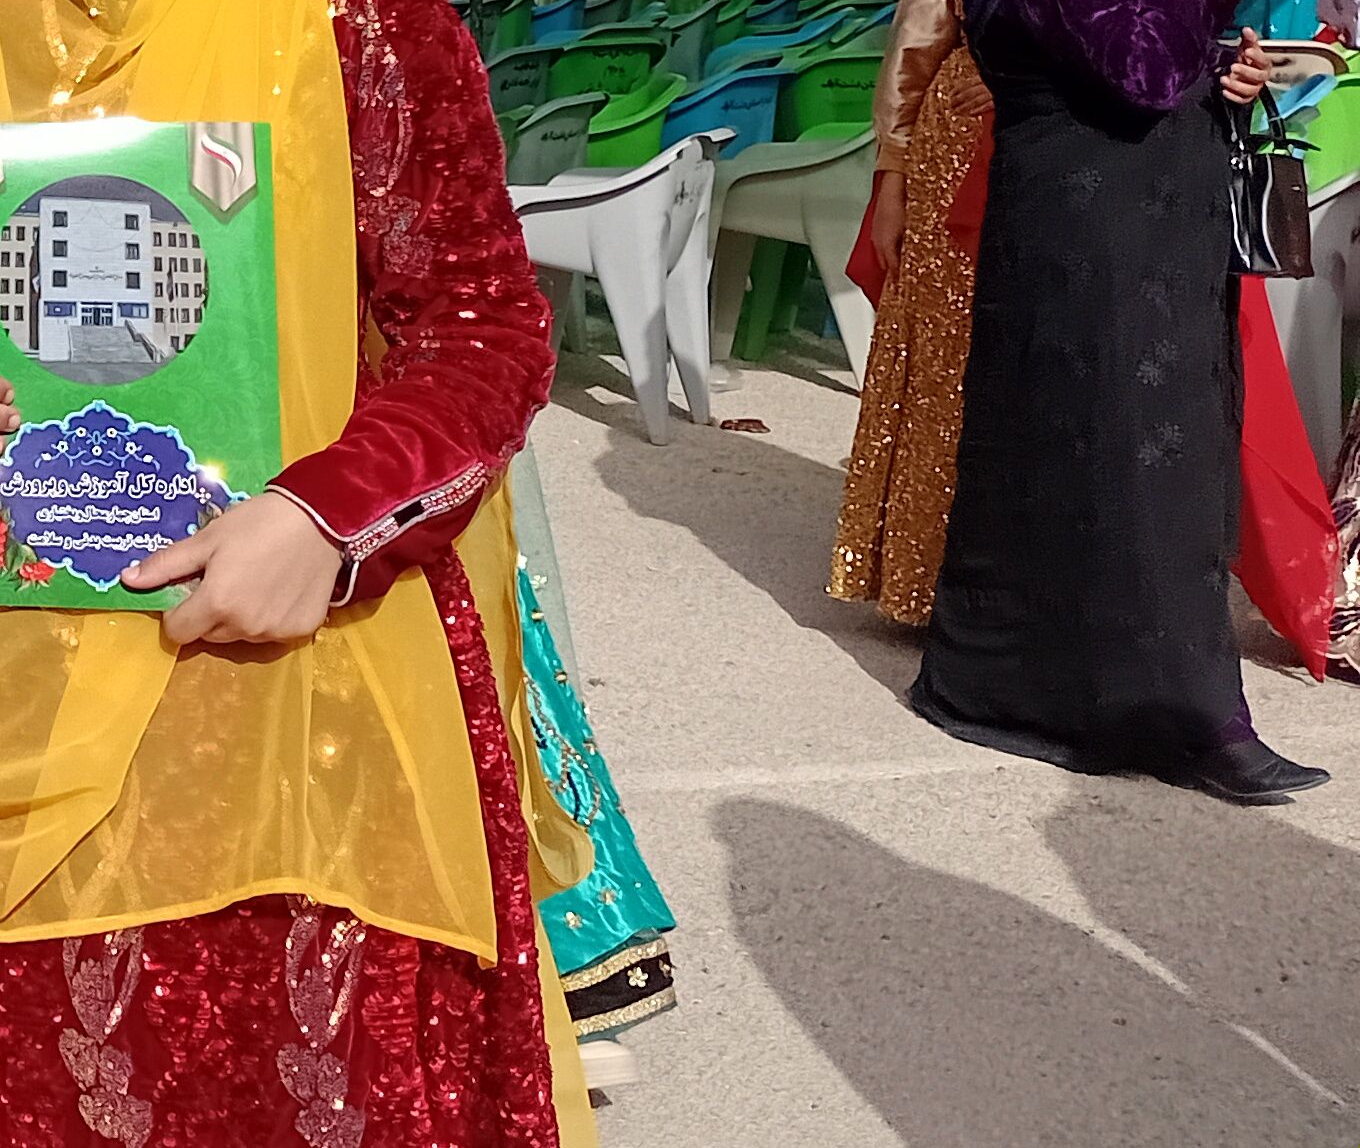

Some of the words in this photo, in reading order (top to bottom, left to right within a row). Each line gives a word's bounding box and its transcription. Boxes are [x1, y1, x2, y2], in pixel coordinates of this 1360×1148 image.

[0, 471, 58, 498] پرورش
[57, 479, 69, 497] و
[68, 471, 130, 498] آموزش
[128, 473, 156, 498] کل
[155, 475, 197, 500] اداره
[36, 505, 77, 523] بختیاری
[130, 506, 160, 522] استان
[27, 531, 63, 546] سلامت
[63, 536, 73, 550] و
